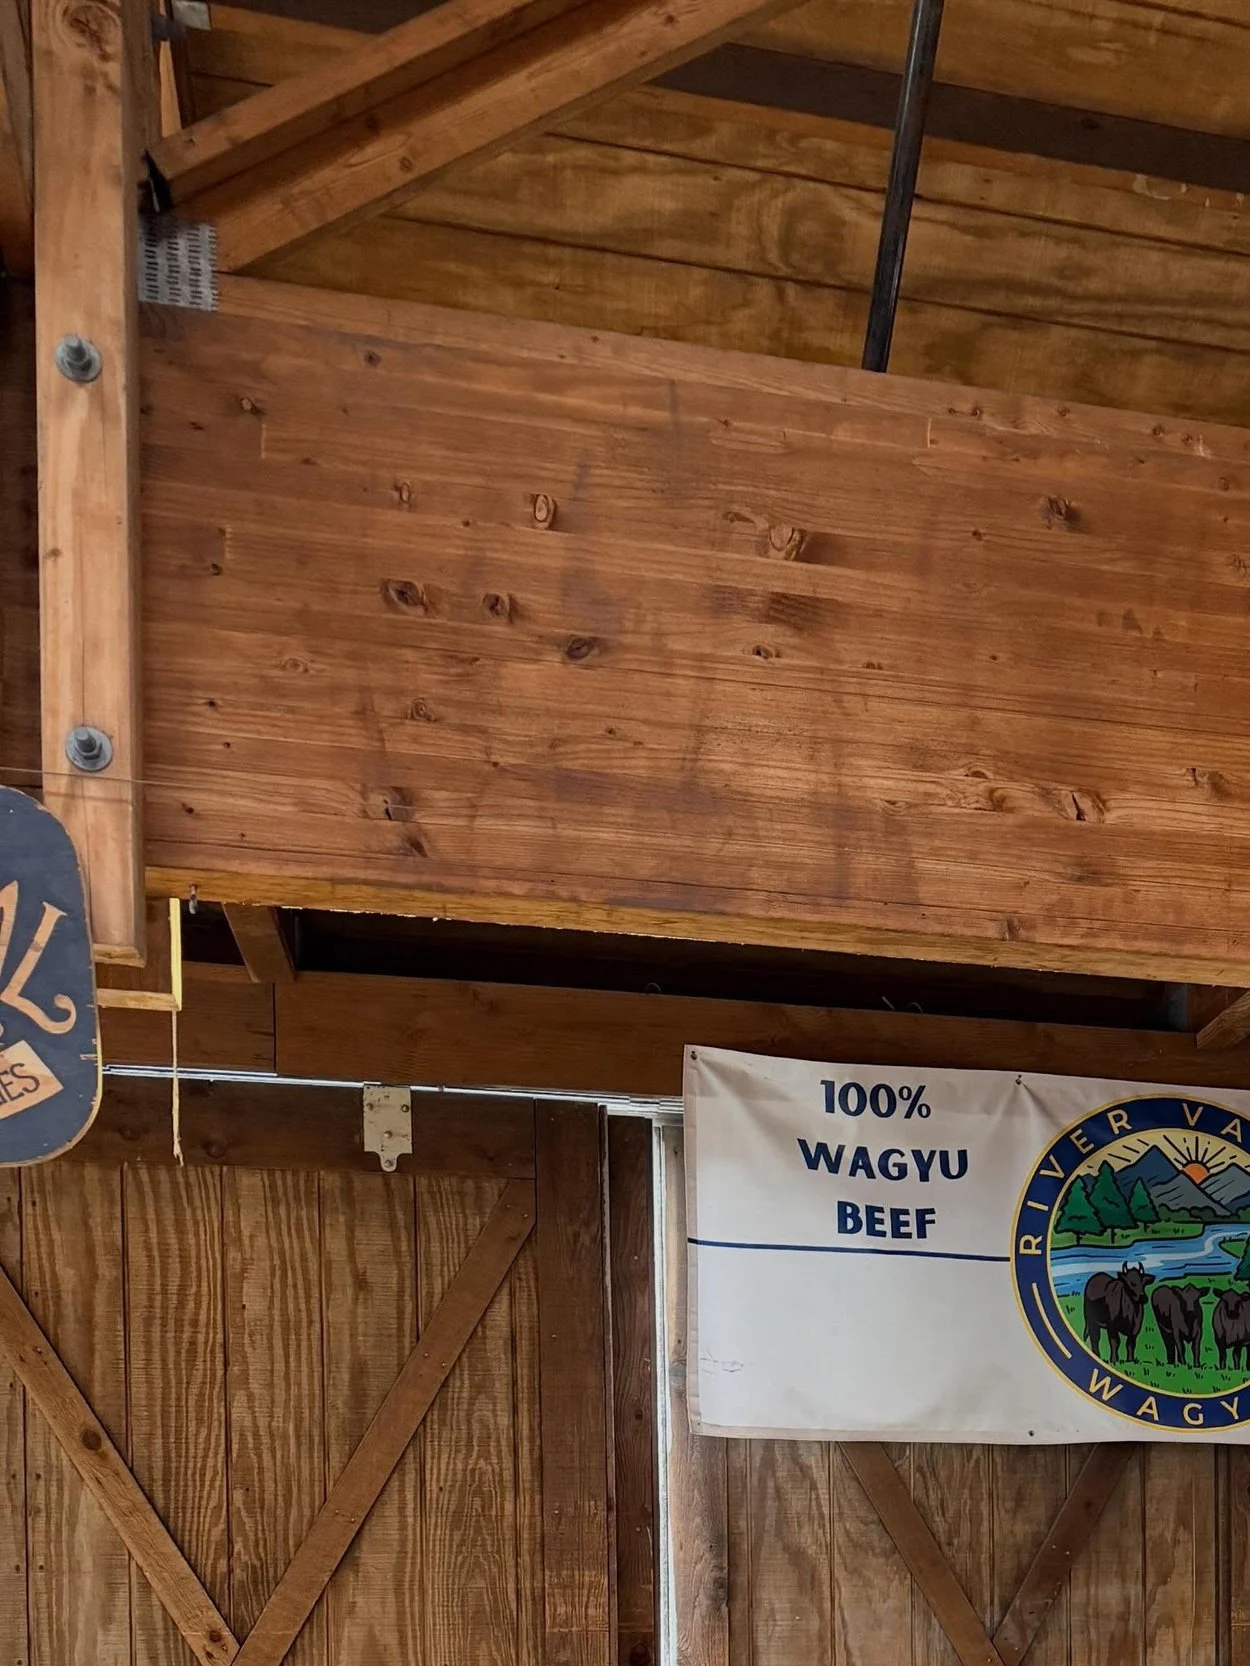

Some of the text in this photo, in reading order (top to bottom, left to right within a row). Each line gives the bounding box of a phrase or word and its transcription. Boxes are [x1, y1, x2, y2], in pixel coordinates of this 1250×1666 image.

[819, 1079, 933, 1120] 100%
[796, 1137, 970, 1183] WAGYU
[1018, 1108, 1132, 1256] RIVER
[836, 1200, 937, 1241] BEEF
